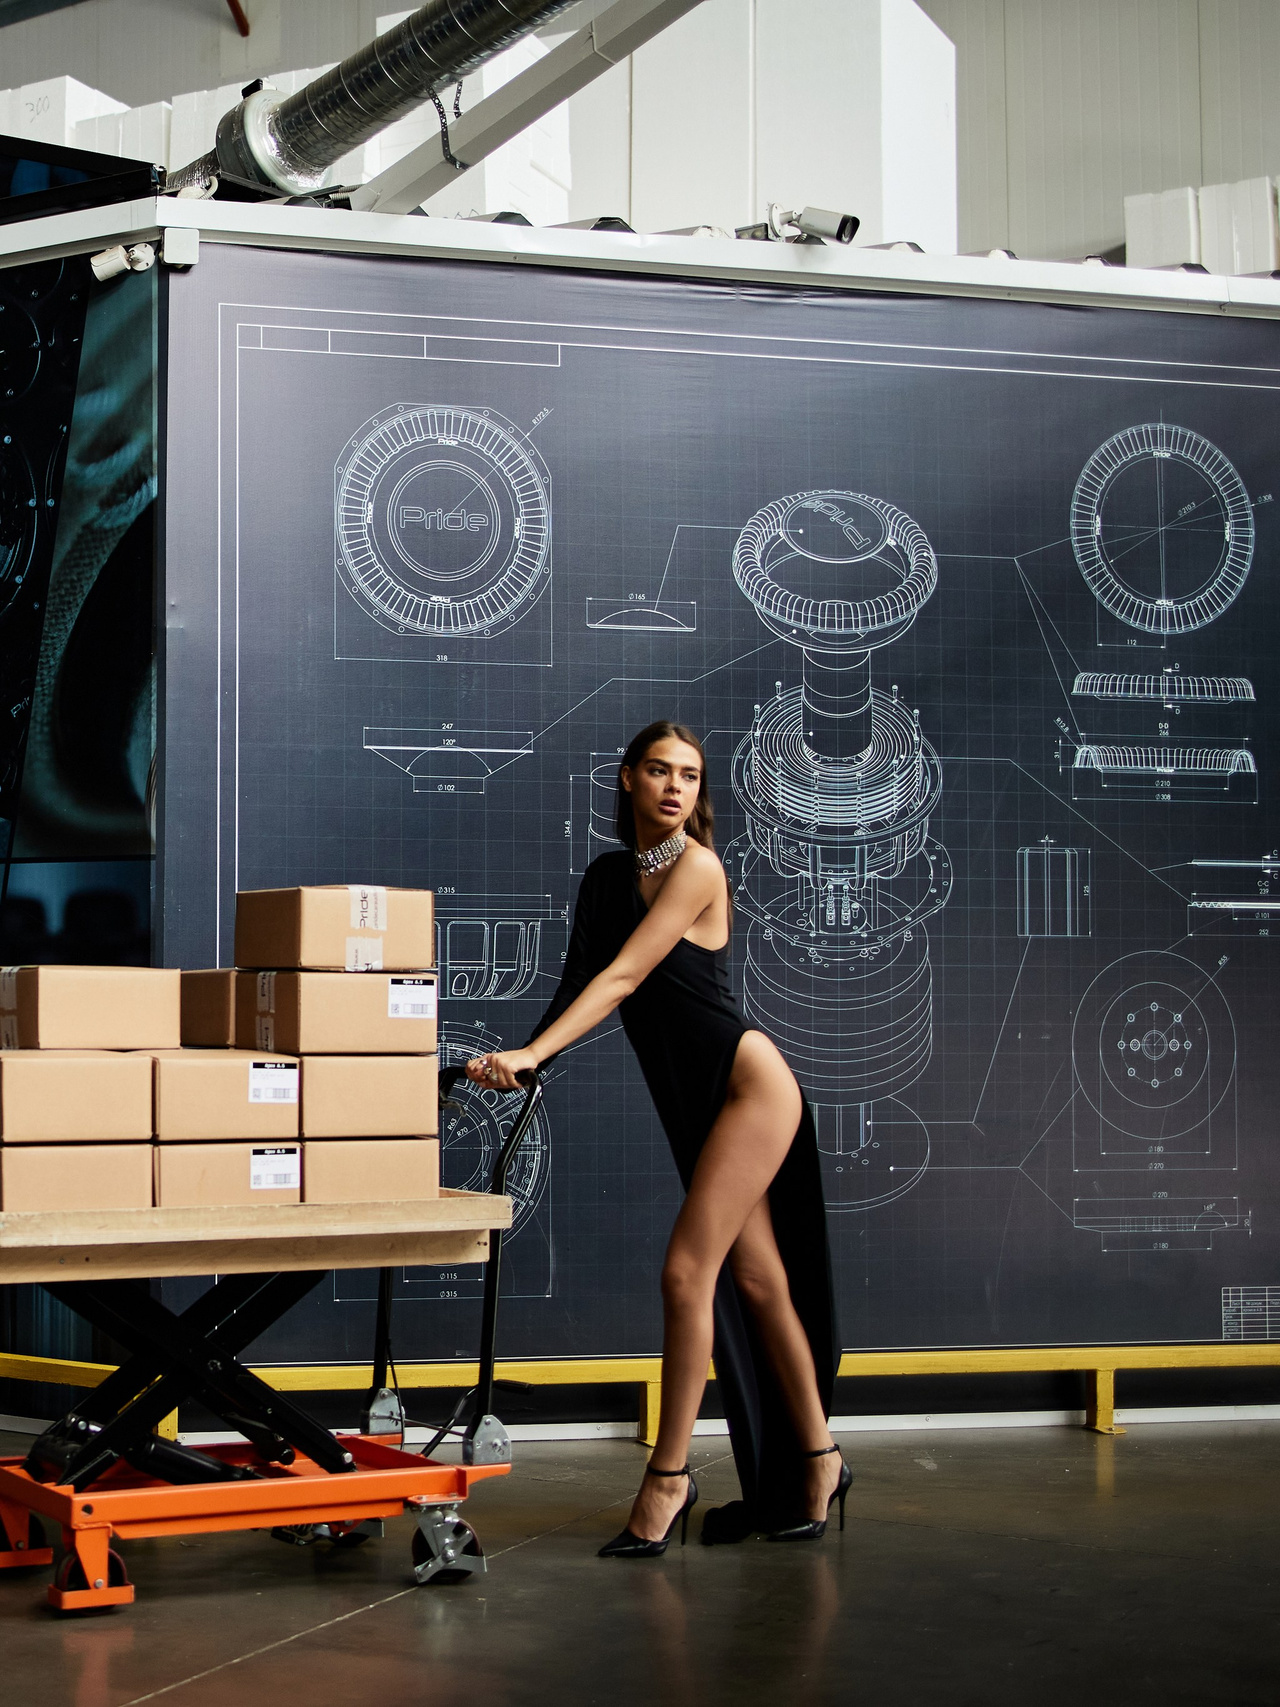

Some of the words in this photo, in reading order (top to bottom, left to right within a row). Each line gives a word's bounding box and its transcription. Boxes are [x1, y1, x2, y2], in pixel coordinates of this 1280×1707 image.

[531, 407, 550, 425] R172.5
[438, 437, 459, 446] Pride
[399, 505, 489, 532] Pride
[801, 499, 871, 550] Pride
[436, 654, 448, 662] 318
[10, 696, 31, 718] Pri
[437, 886, 455, 894] Ø315
[359, 889, 369, 929] Pride
[560, 910, 567, 919] 12
[447, 1118, 457, 1131] R63
[456, 1126, 469, 1137] R70
[439, 1272, 458, 1280] Ø115
[439, 1290, 458, 1298] Ø315
